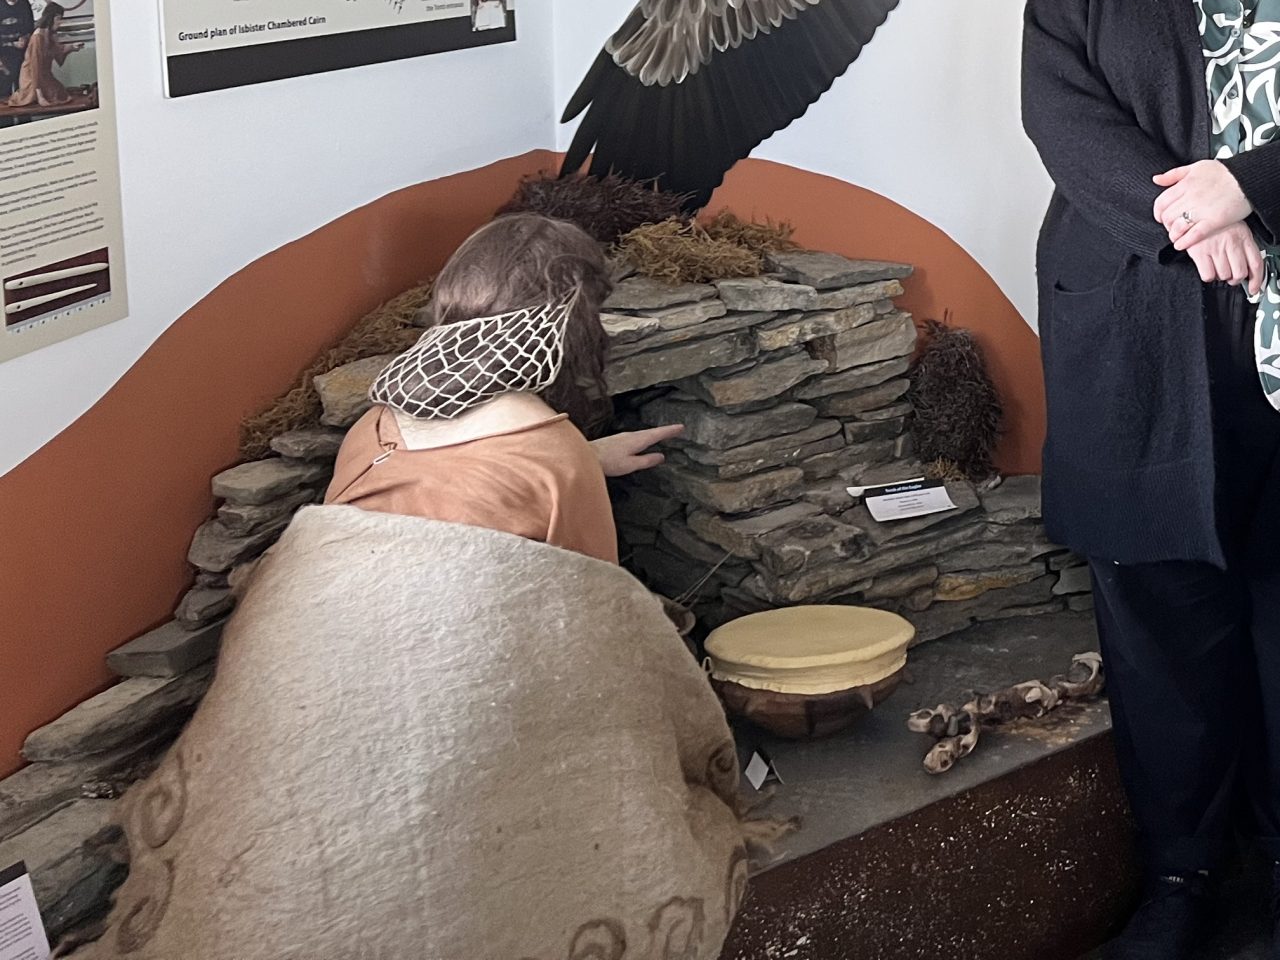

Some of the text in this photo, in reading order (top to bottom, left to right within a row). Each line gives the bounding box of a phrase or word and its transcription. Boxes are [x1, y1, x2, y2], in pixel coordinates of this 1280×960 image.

[178, 29, 209, 41] Ground
[210, 28, 227, 39] plan
[229, 26, 237, 35] of
[239, 24, 266, 34] Isbister
[267, 17, 307, 30] Chambered
